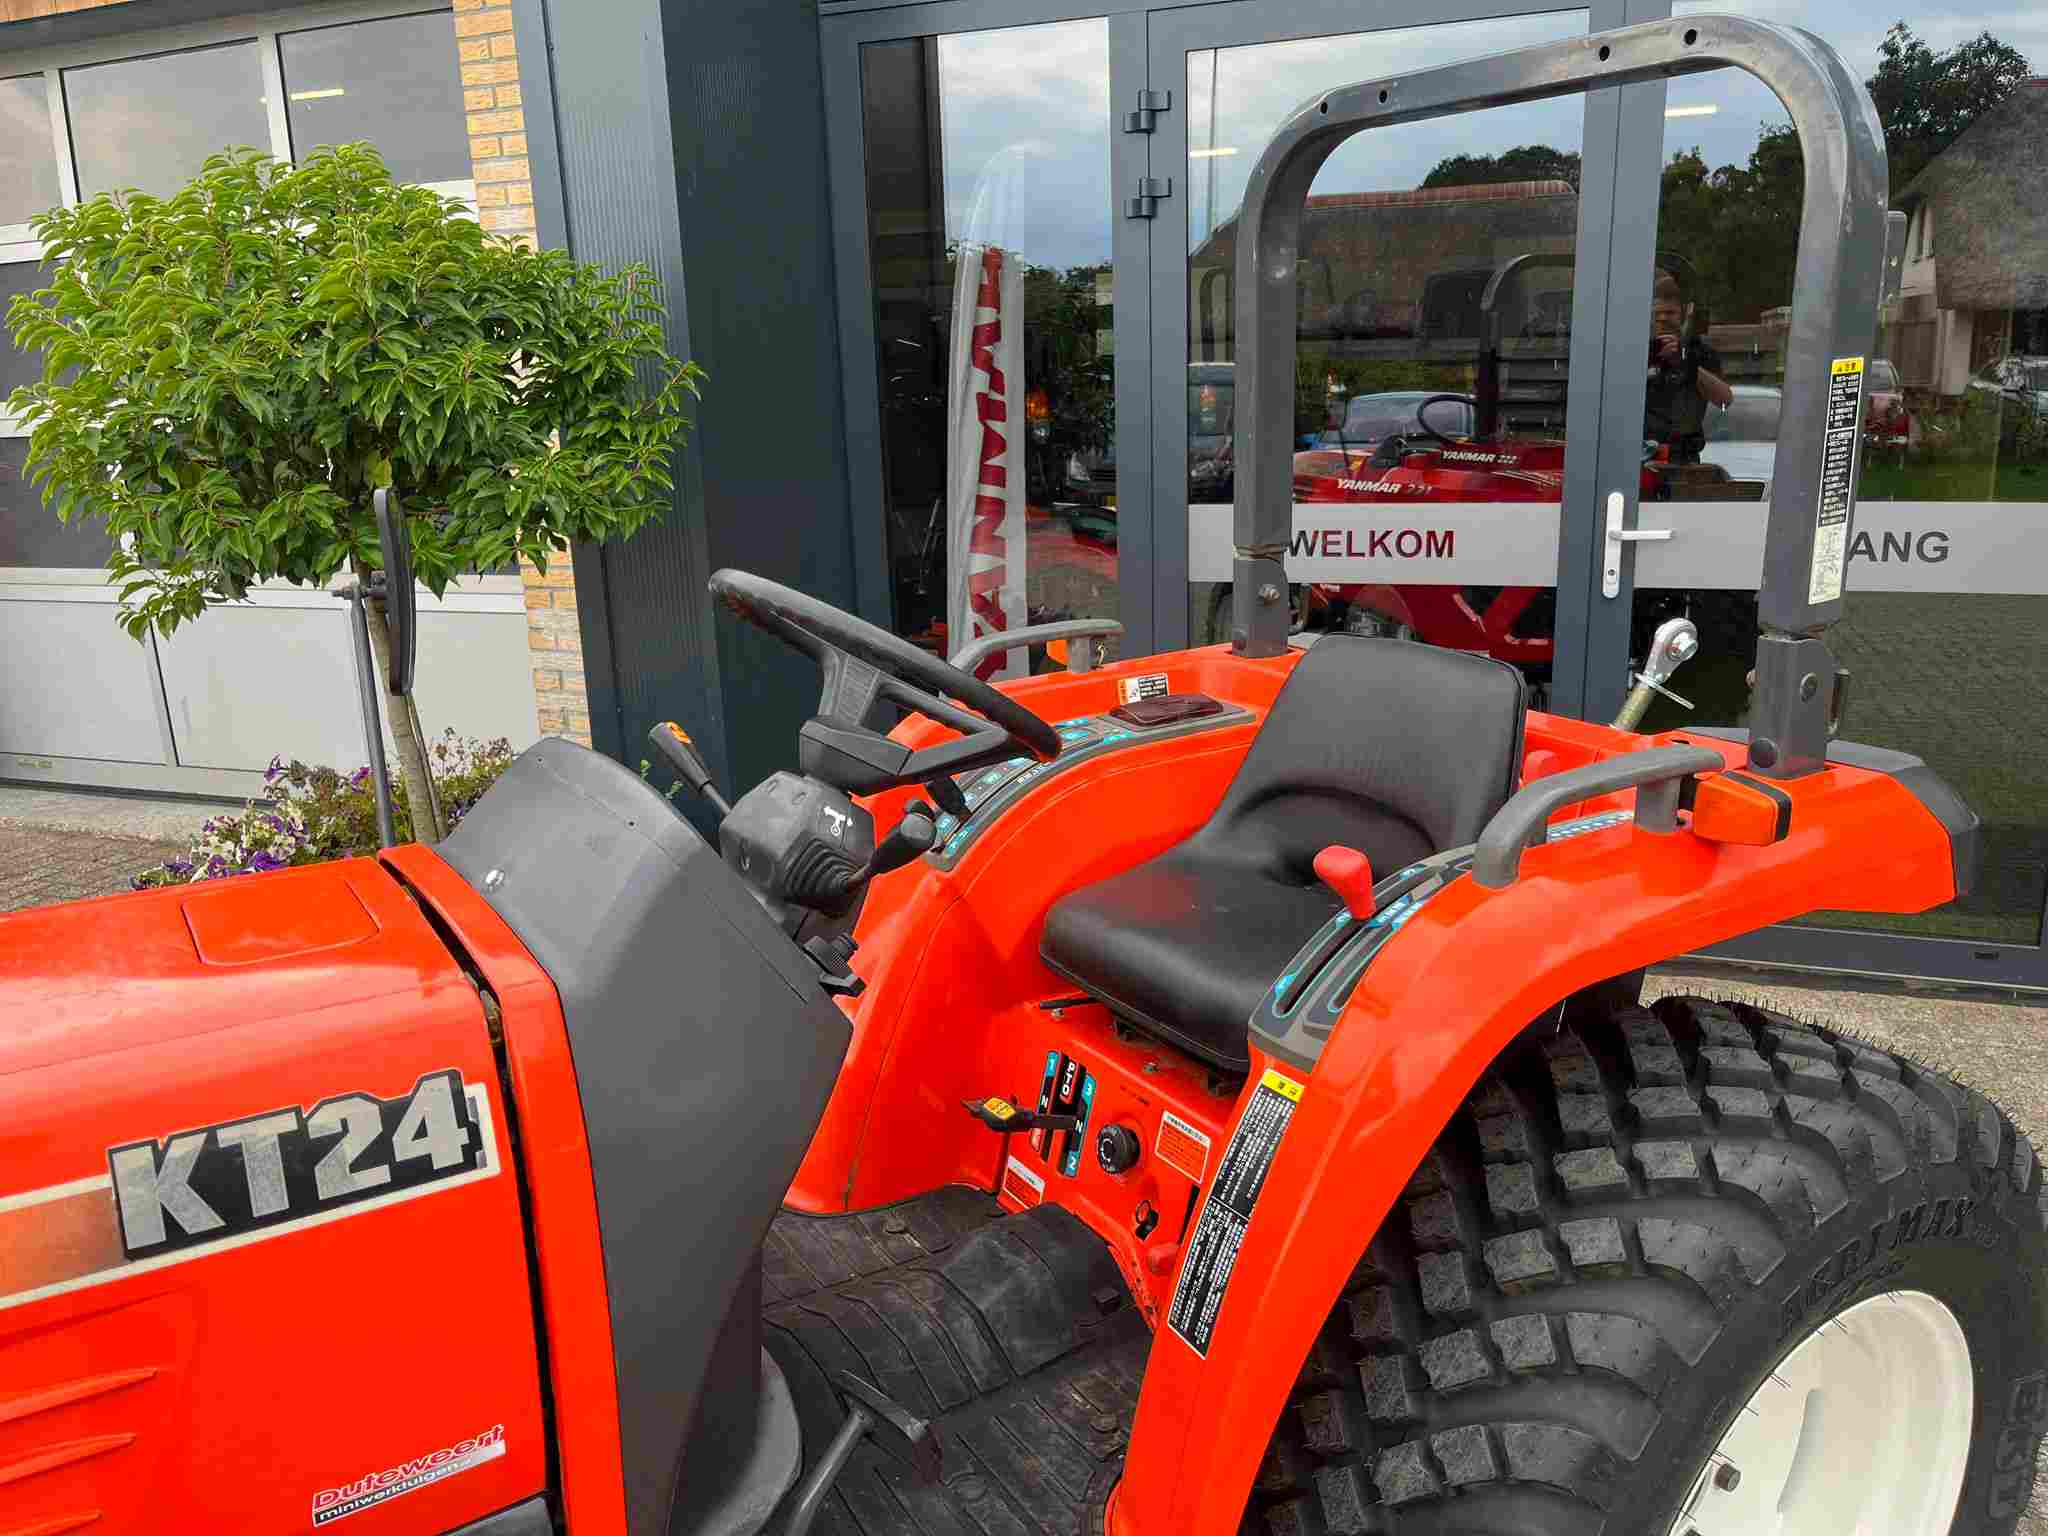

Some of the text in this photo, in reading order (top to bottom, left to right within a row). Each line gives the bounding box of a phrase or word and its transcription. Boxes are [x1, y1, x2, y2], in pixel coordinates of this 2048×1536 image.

[1442, 450, 1495, 464] YANMAR
[1336, 478, 1402, 494] YANMAR
[1289, 530, 1455, 559] WELKOM
[1061, 1061, 1076, 1096] PTO
[1040, 1095, 1049, 1109] N
[1075, 1119, 1084, 1133] N
[110, 1073, 471, 1251] KT24
[313, 1424, 504, 1510] Duteweert
